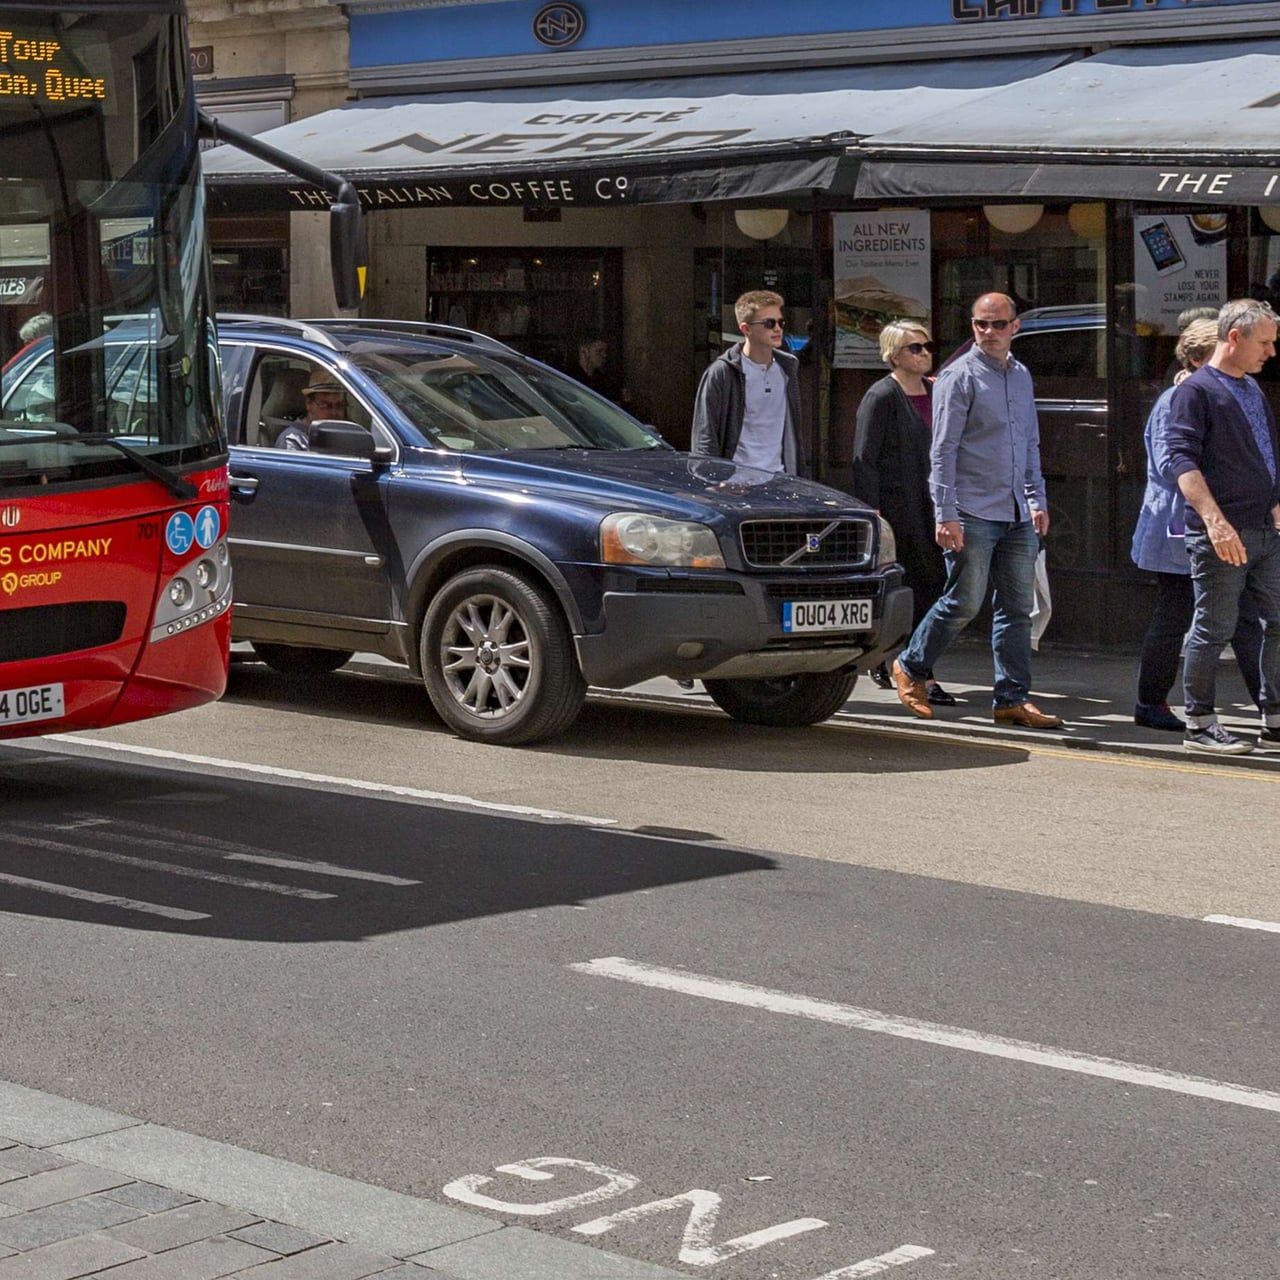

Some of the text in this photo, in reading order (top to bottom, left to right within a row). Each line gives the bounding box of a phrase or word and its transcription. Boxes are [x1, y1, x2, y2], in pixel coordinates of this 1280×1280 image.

[470, 179, 574, 202] COFFEE
[1156, 173, 1233, 194] THE
[853, 223, 911, 236] ALL NEW
[839, 238, 926, 252] INGREDIENTS
[1194, 269, 1220, 279] NEVER
[1178, 280, 1220, 290] LOSE YOUR
[1163, 292, 1220, 302] STAMPS AGAIN
[137, 523, 159, 540] 701
[18, 537, 113, 563] COMPANY
[19, 571, 62, 588] GROUP
[795, 602, 870, 626] OU04 XRG
